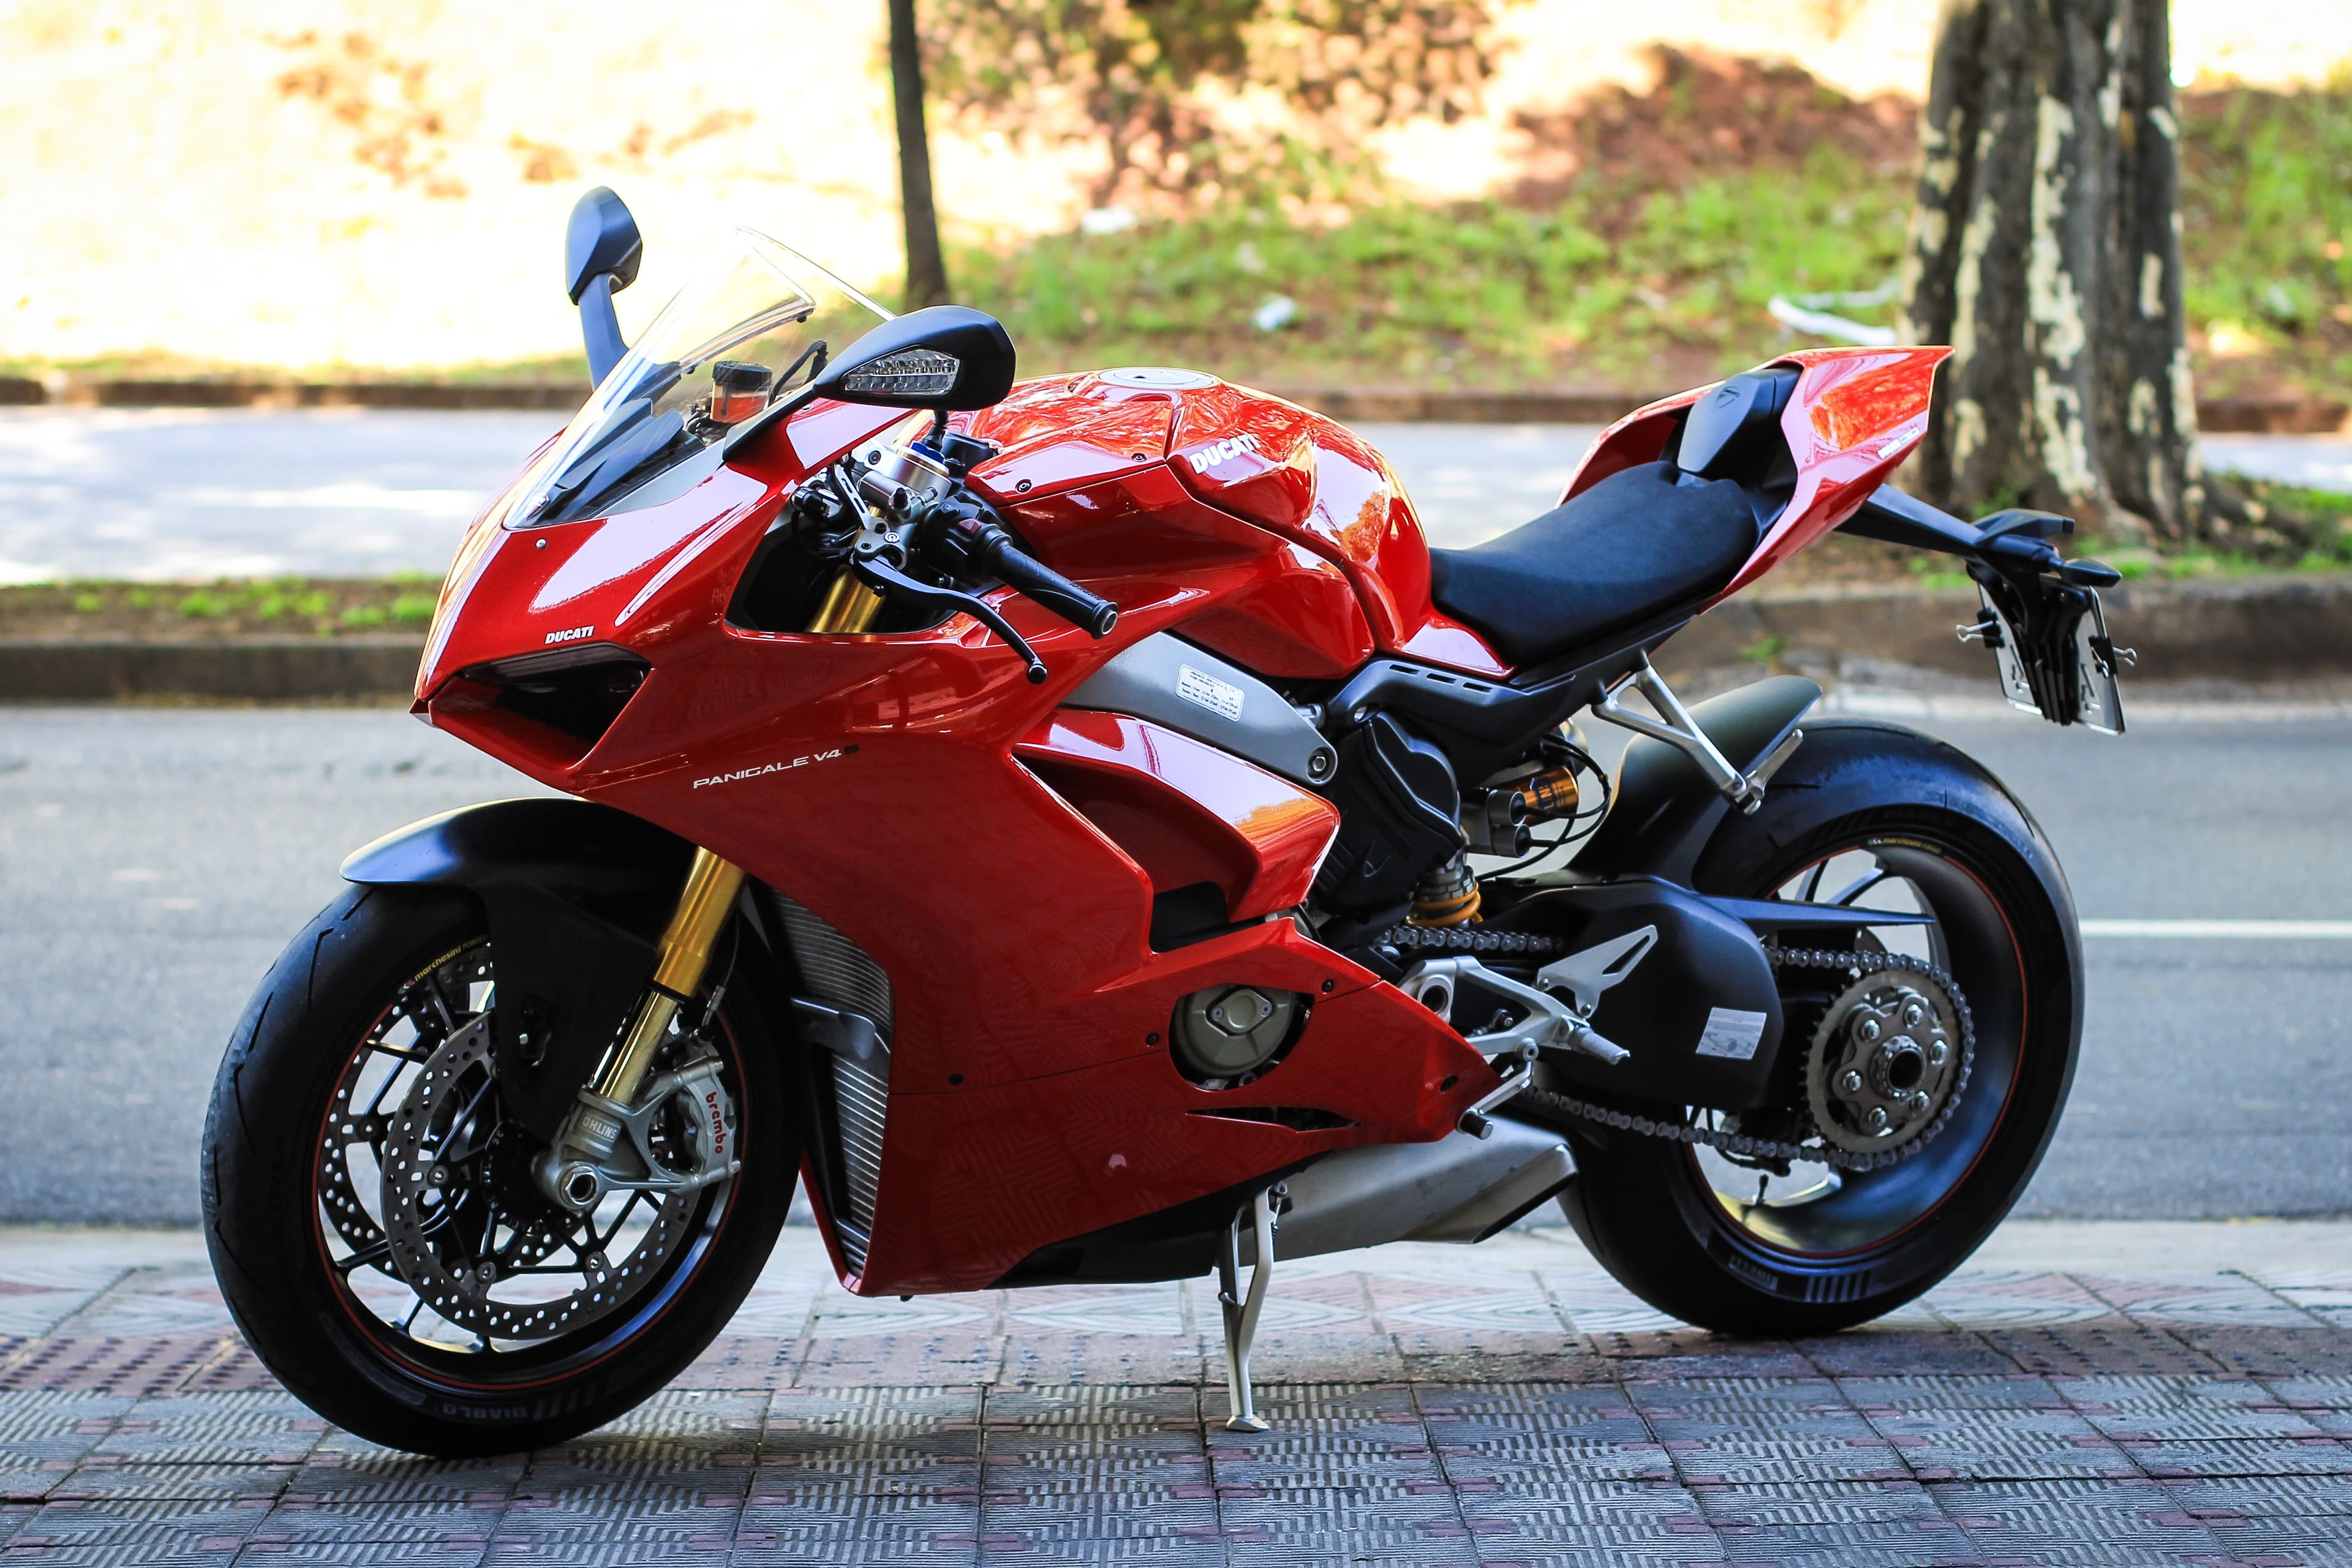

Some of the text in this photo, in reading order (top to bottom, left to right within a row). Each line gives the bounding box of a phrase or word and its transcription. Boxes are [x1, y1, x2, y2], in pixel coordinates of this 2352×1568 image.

[1189, 434, 1262, 474] DUCATI
[545, 625, 595, 645] DUCATI
[693, 756, 810, 789] PANIGALE
[813, 748, 842, 762] V4
[415, 944, 461, 981] marchesini
[705, 1091, 727, 1155] brembo
